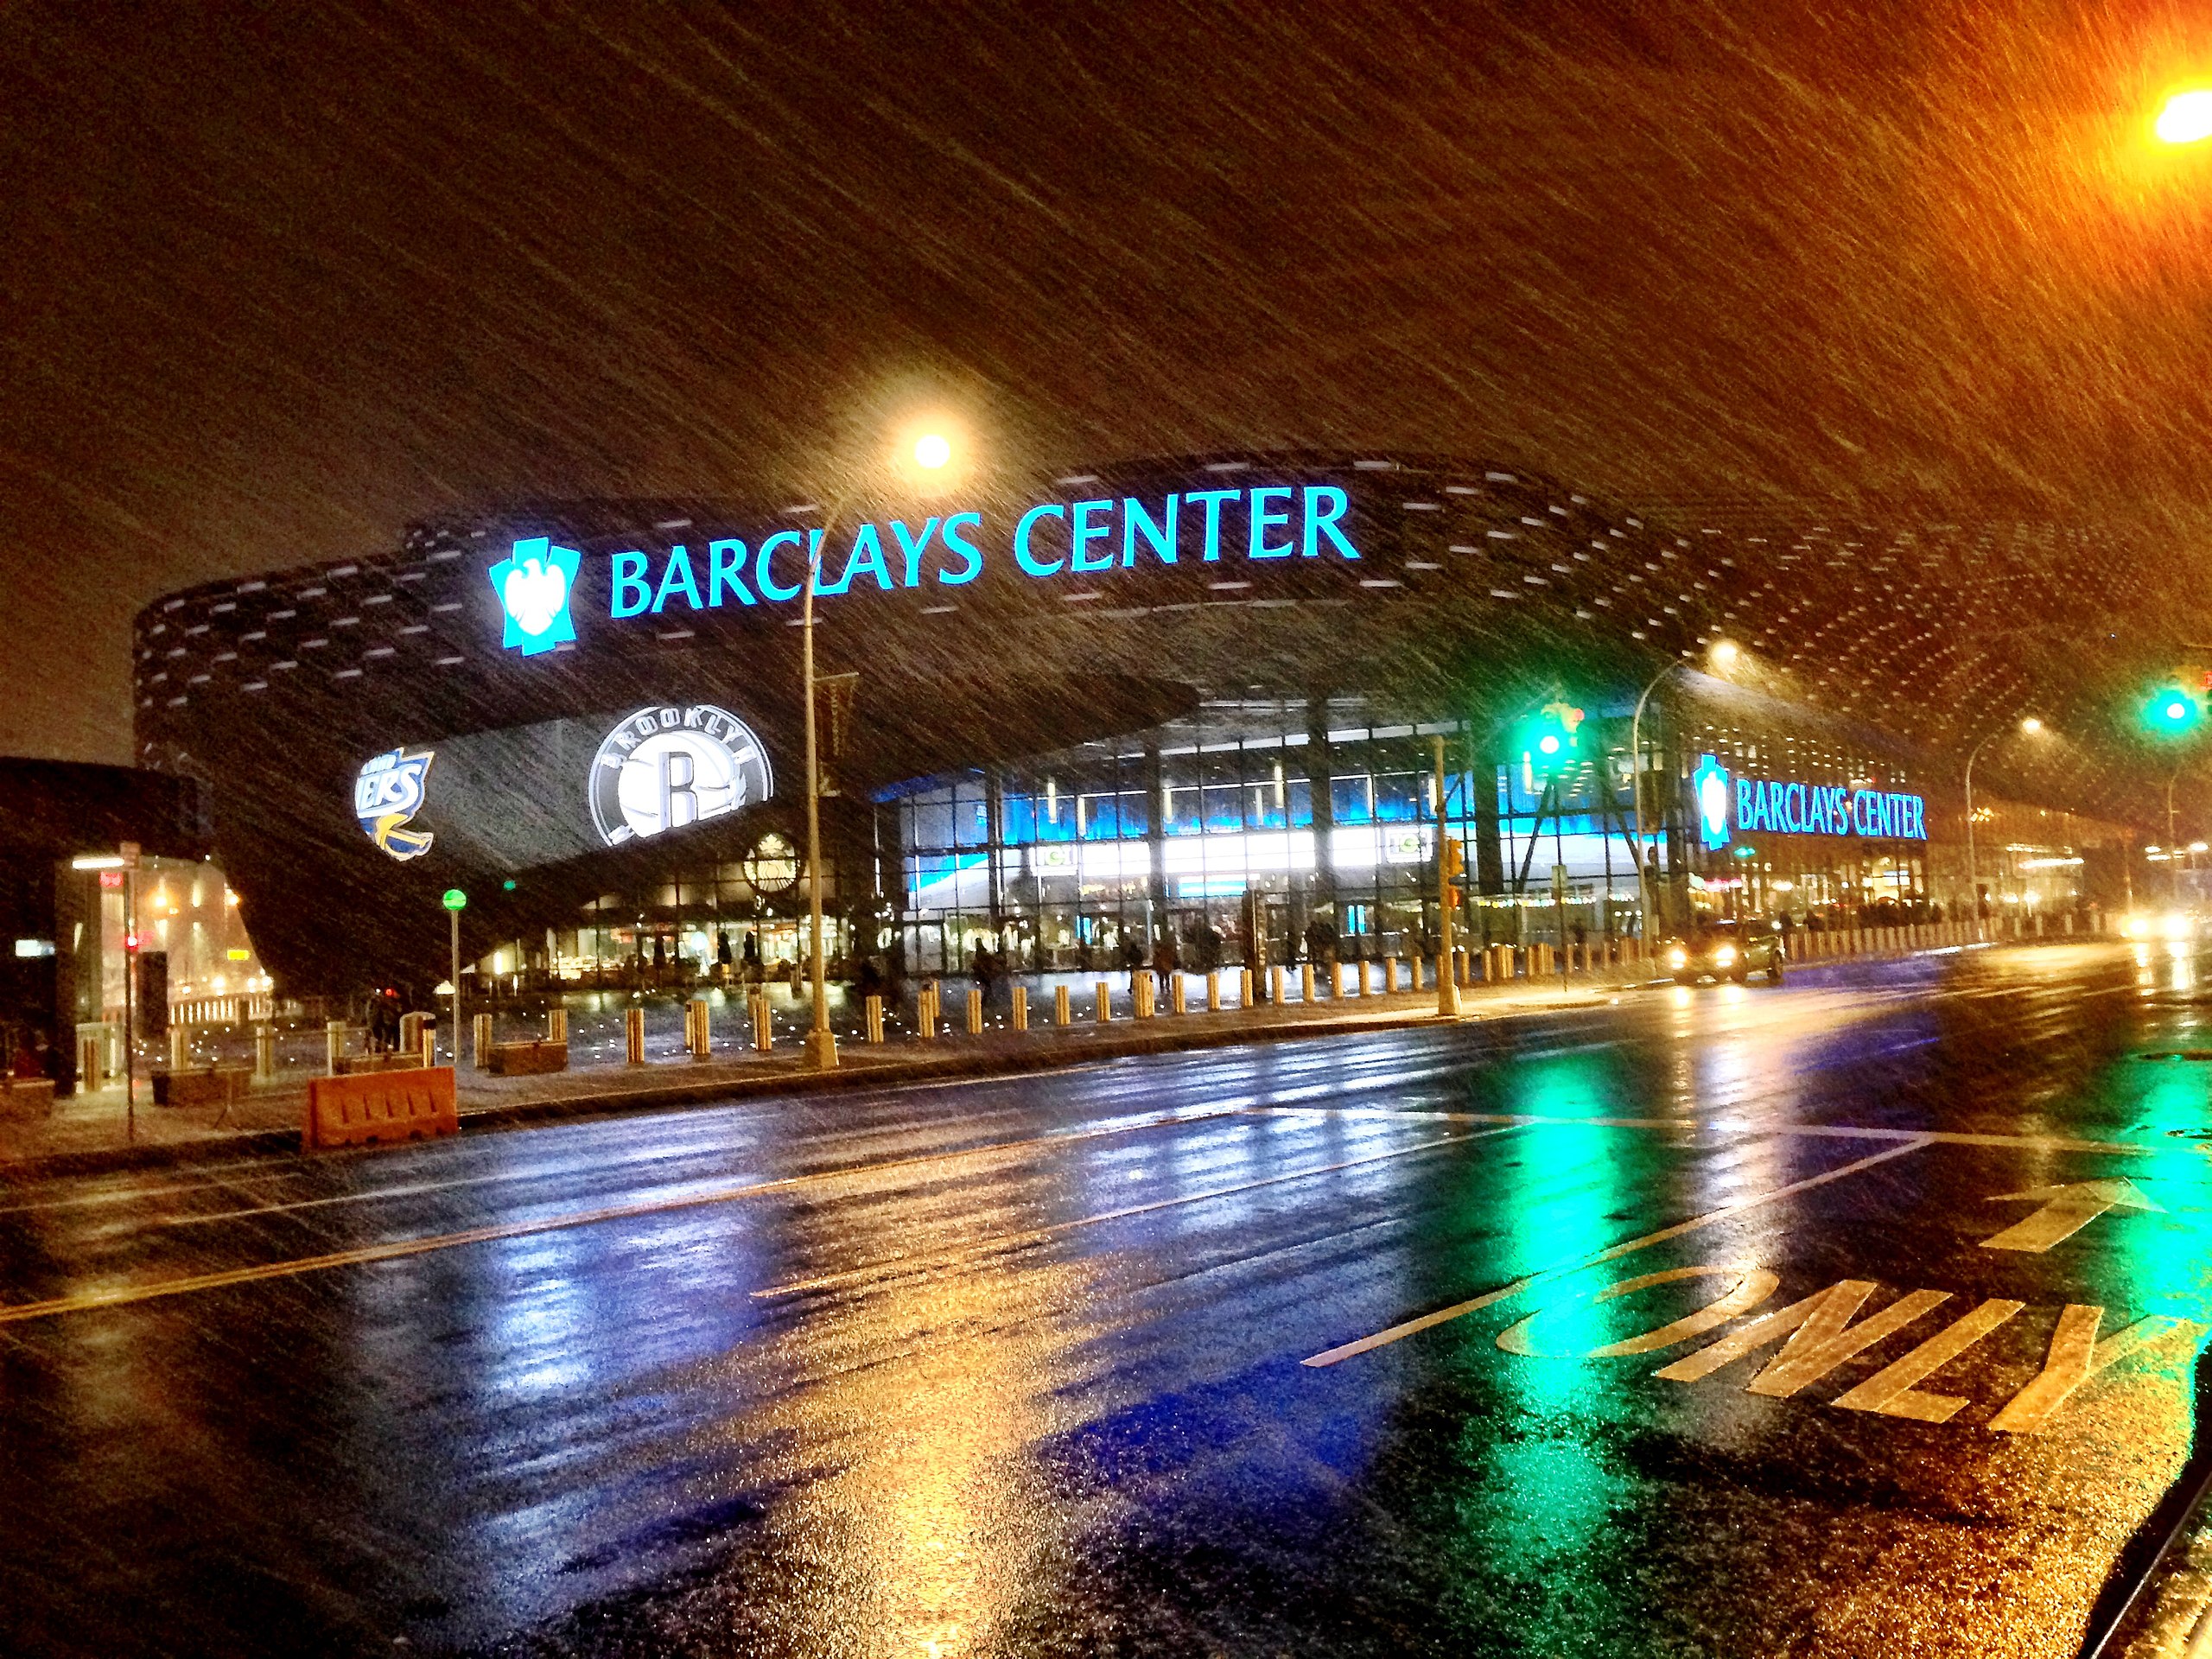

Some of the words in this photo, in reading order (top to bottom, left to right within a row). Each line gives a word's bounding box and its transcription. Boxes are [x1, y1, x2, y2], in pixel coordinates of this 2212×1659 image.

[611, 511, 983, 619] BARCLAYS
[1014, 486, 1362, 577] CENTER
[600, 707, 758, 769] BROOKLYN
[1737, 779, 1848, 835] BARCLAYS
[1853, 790, 1927, 840] CENTER
[1496, 1265, 2197, 1435] ONLY
